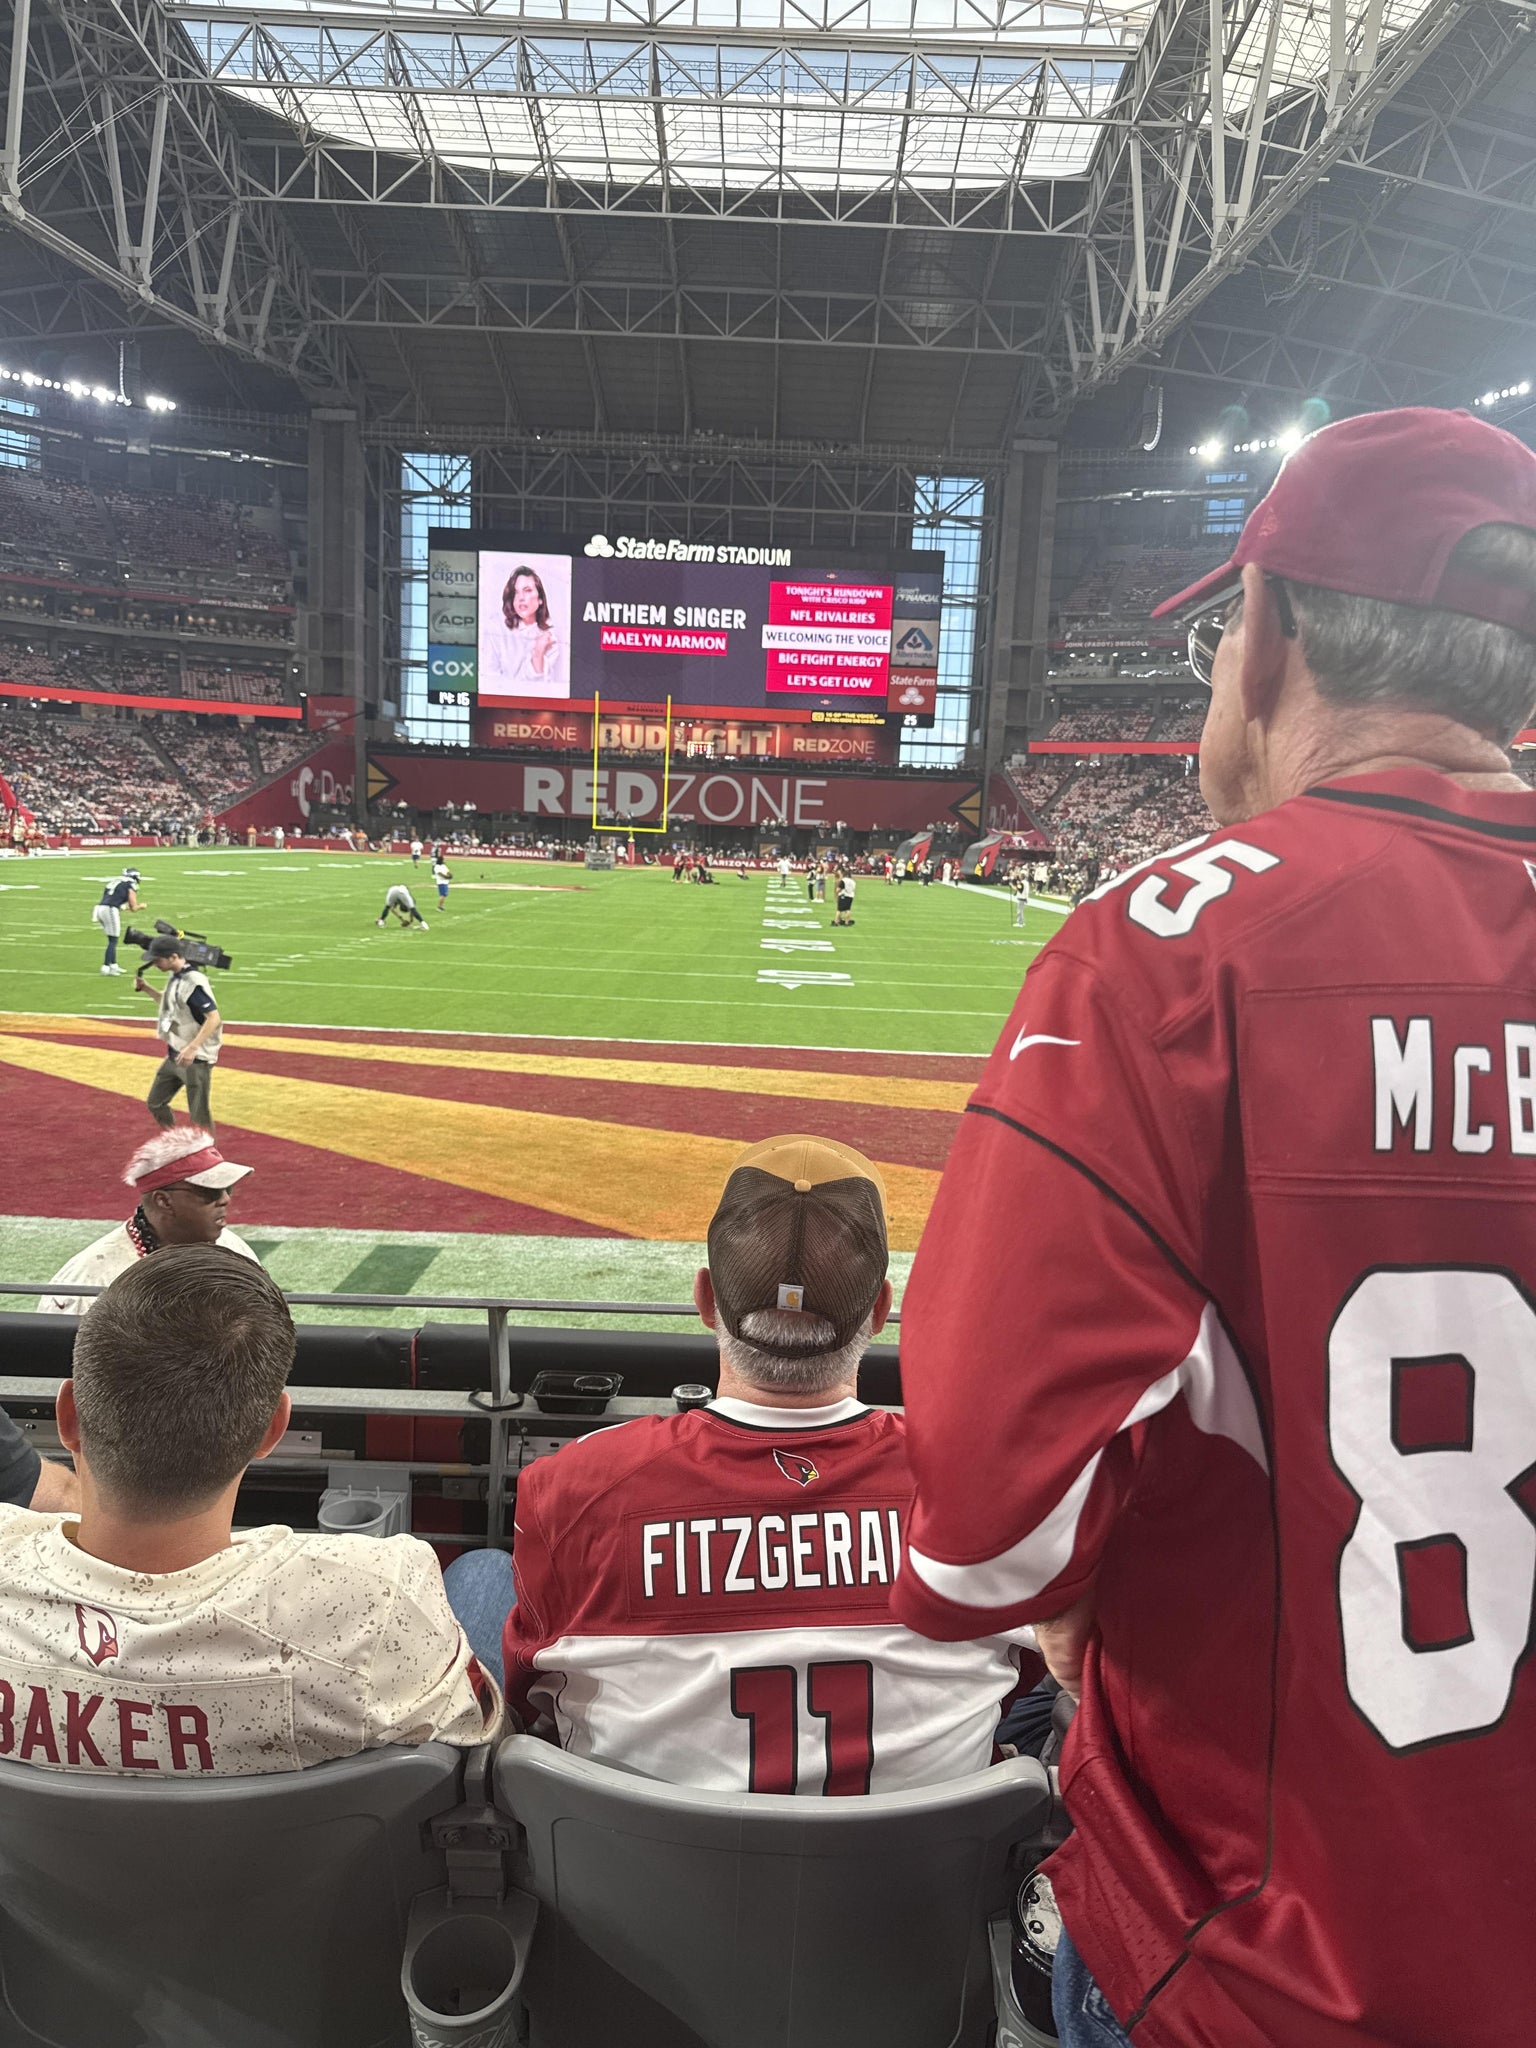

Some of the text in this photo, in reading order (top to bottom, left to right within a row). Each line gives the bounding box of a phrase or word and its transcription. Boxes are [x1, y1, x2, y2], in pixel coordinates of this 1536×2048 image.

[716, 546, 791, 566] STADIUM
[785, 586, 883, 600] TONIGHT'S RUNDOWN
[439, 615, 475, 626] ACP
[583, 601, 746, 629] ANTHEM SINGER
[790, 610, 876, 624] NFL RIVALRIES
[602, 631, 726, 650] MAELYN JARMON
[766, 631, 888, 646] WELCOMING THE VOICE
[778, 653, 883, 668] BIG FIGHT ENERGY
[432, 660, 475, 677] COX
[787, 674, 873, 689] LET'S GET LOW
[599, 723, 667, 751] BUD
[446, 847, 492, 855] ARIONA
[730, 1659, 874, 1796] 11
